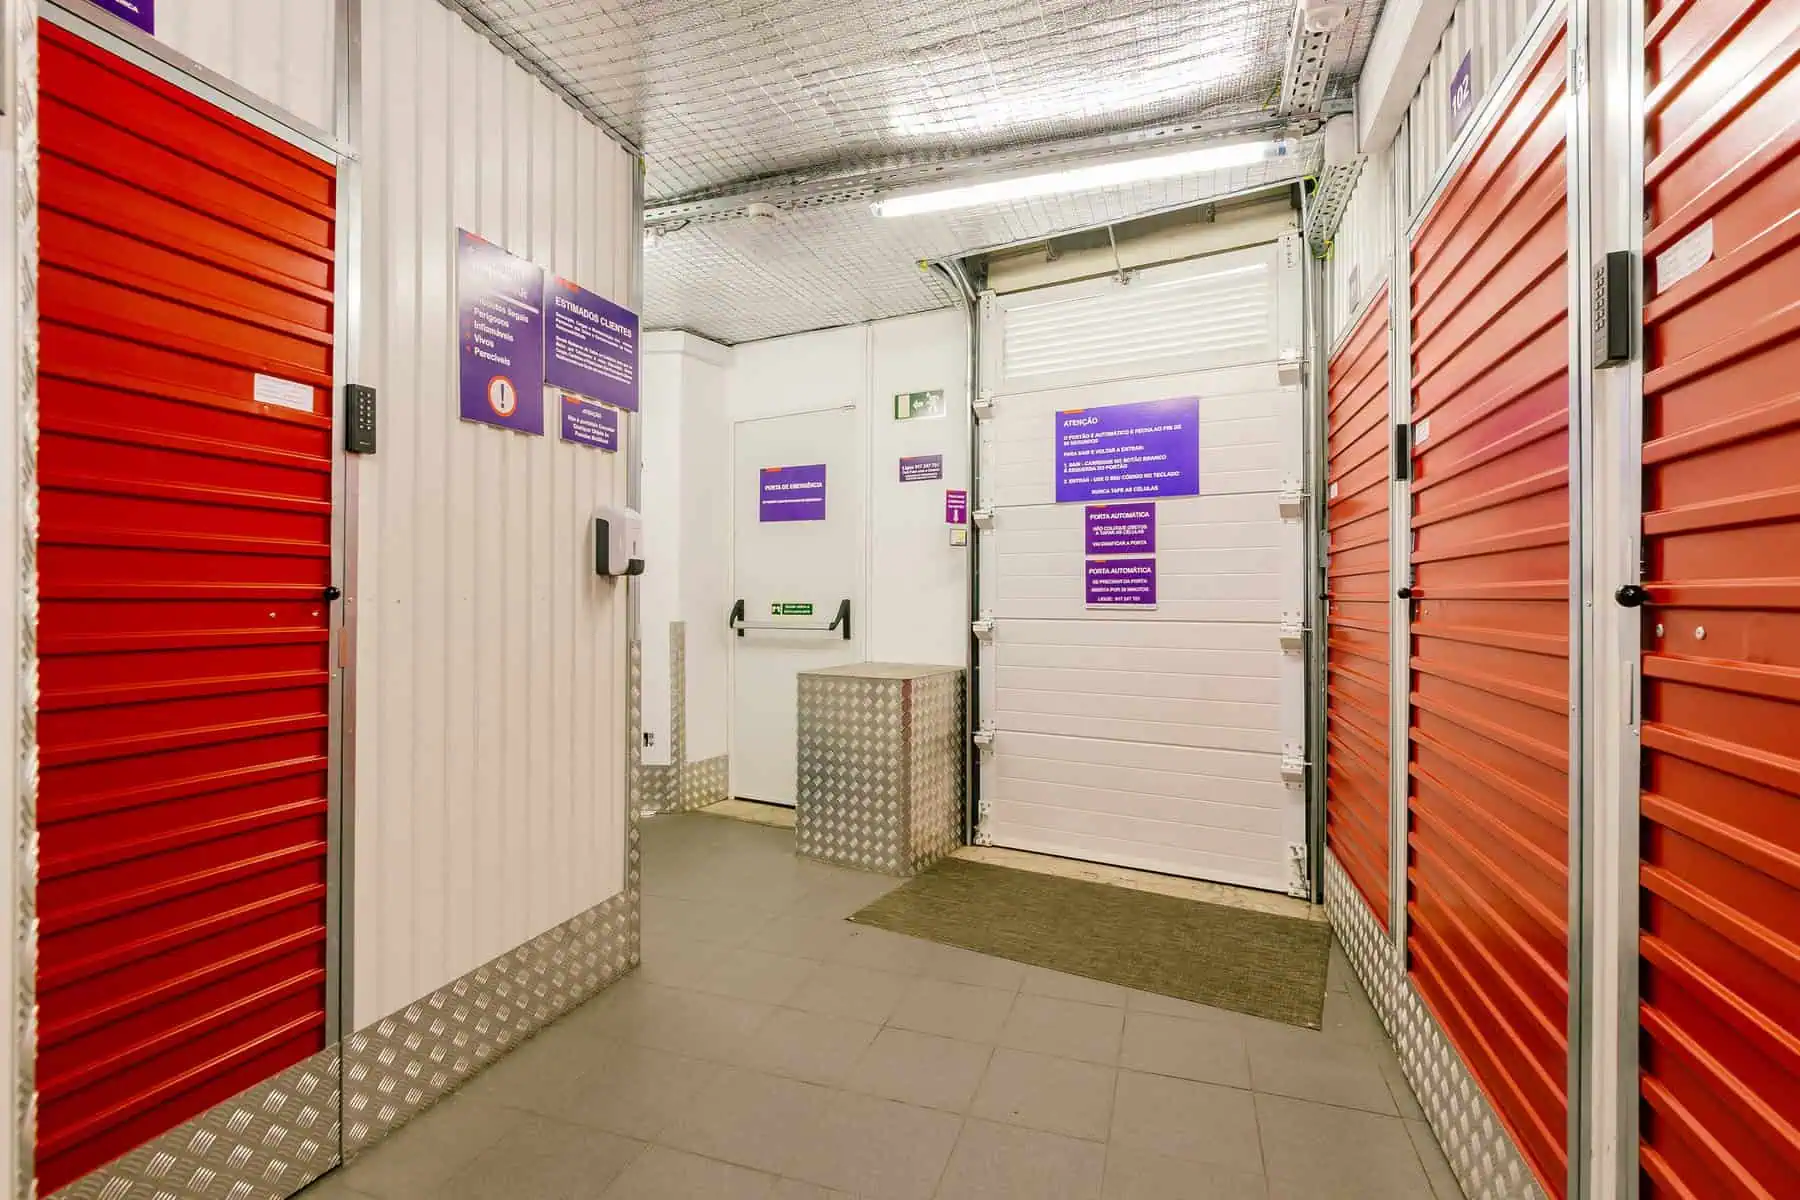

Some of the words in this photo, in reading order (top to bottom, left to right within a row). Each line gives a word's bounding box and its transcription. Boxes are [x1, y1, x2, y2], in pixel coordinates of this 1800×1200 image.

[1452, 74, 1469, 117] 102
[474, 307, 509, 328] Perigosos
[555, 296, 600, 324] ESTIMADOS
[600, 317, 632, 339] CLIENTES
[474, 333, 494, 348] Vivos
[474, 346, 511, 366] Perecíveis
[1064, 416, 1098, 427] ATENÇÃO
